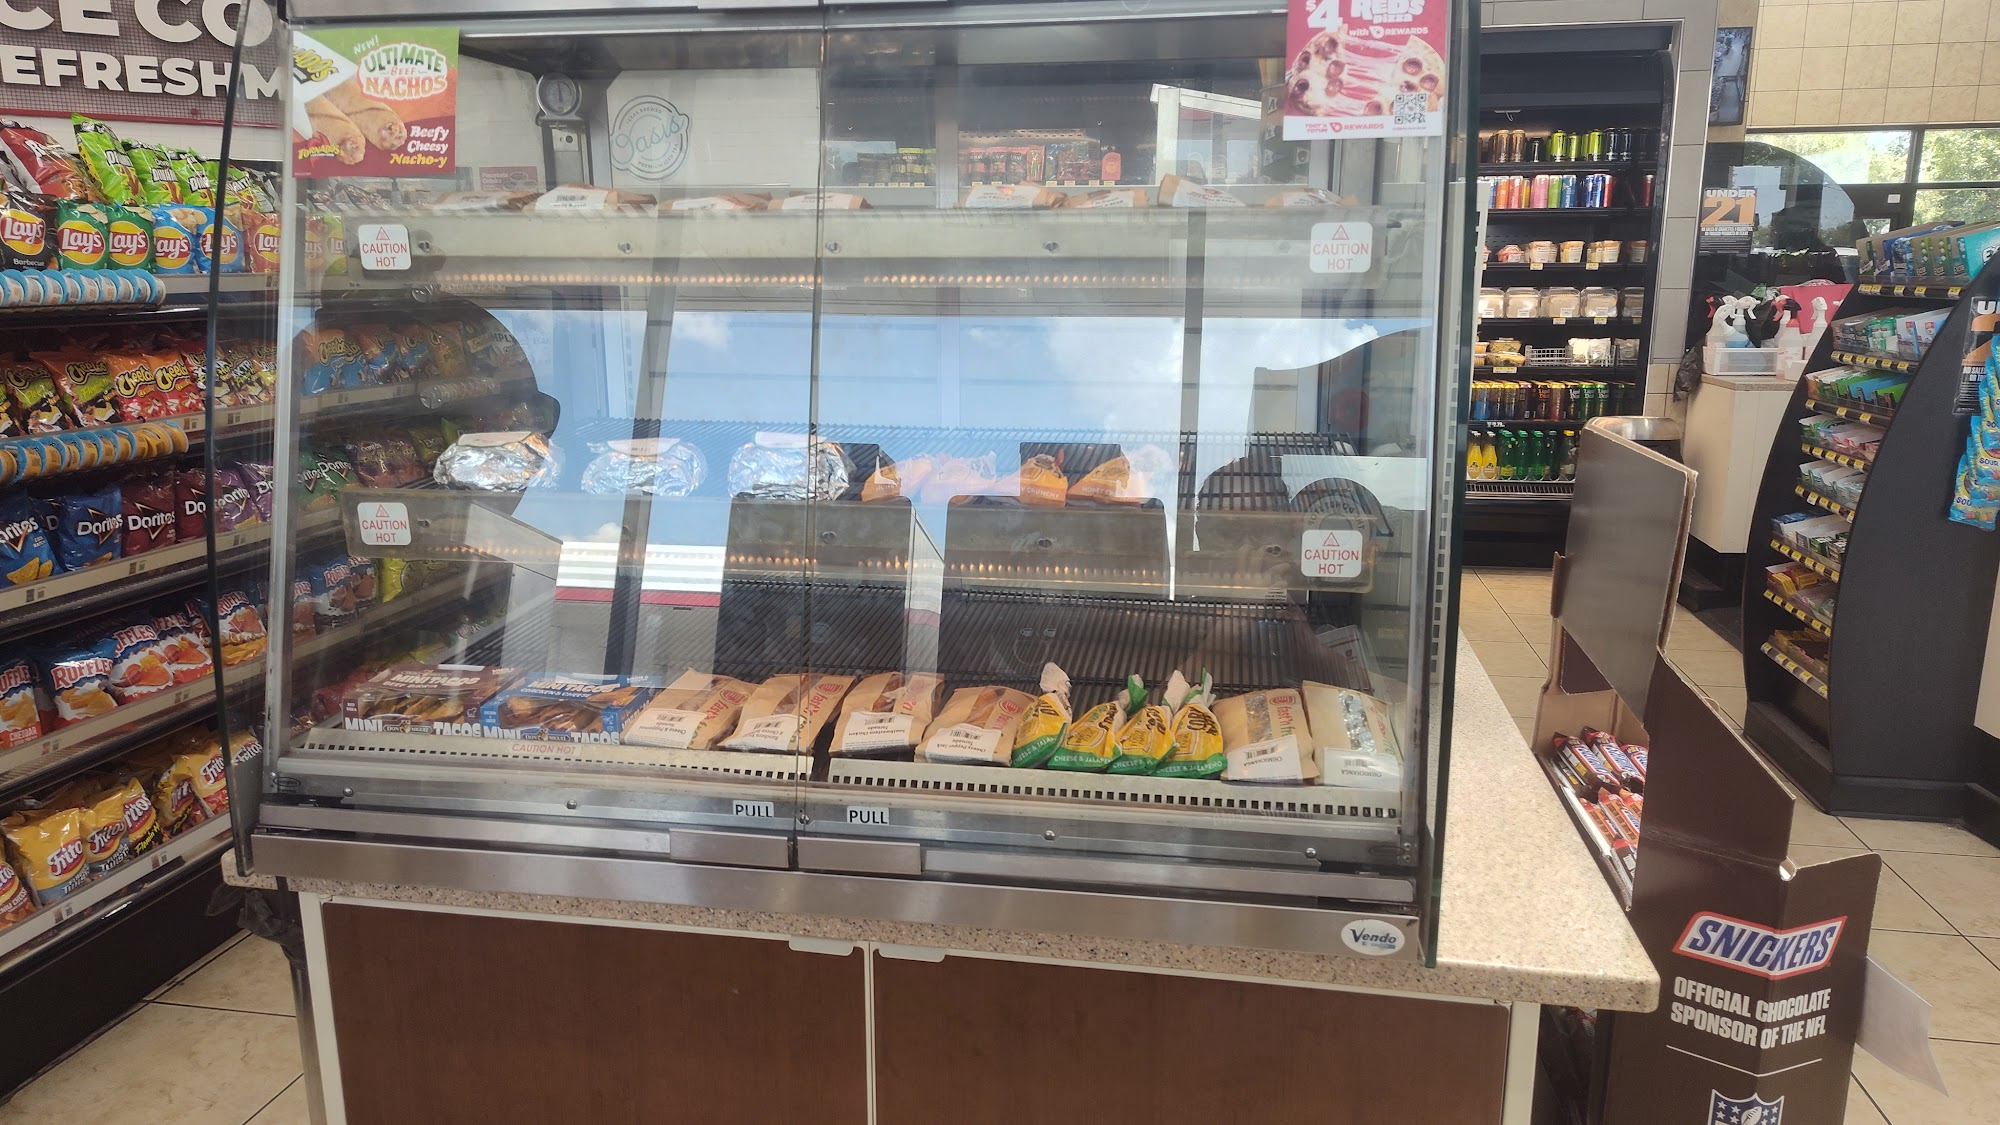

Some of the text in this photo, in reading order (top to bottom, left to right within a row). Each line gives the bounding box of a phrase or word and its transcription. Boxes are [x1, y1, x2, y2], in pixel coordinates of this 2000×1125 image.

[1349, 27, 1428, 36] with REWARDS
[363, 44, 445, 72] ULTIMATE
[391, 67, 416, 75] BEEF
[365, 75, 447, 98] NACHOS
[410, 126, 449, 141] Beefy
[298, 145, 341, 160] TORNADOS
[407, 140, 448, 154] Cheesy
[390, 153, 447, 168] Nacho-y
[1706, 189, 1756, 198] UNDER
[1701, 197, 1756, 226] 21
[4, 218, 44, 244] Lay's
[62, 229, 102, 254] Lay's
[154, 237, 189, 259] ay's
[362, 243, 407, 254] CAUTION
[1313, 243, 1369, 255] CAUTION
[13, 258, 45, 267] Barbecue
[376, 257, 396, 267] HOT
[1327, 258, 1353, 270] HOT
[117, 364, 153, 398] Cheeto
[155, 360, 190, 391] Cheeto
[1980, 457, 1999, 466] SOUR
[1026, 488, 1060, 498] CRUNCHY
[77, 513, 123, 536] Doritos
[362, 520, 407, 530] CAUTION
[376, 533, 396, 542] HOT
[1304, 549, 1359, 561] CAUTION
[1318, 563, 1344, 575] HOT
[391, 674, 429, 685] MINI
[429, 676, 481, 687] TACOS
[527, 680, 620, 693] MINI TACOS
[345, 717, 383, 732] MINI
[433, 721, 482, 737] TACOS
[483, 726, 521, 740] MINI
[570, 731, 620, 745] TACOS
[512, 743, 577, 754] CAUTION HOT
[1054, 755, 1077, 763] CHEESE
[1243, 756, 1283, 768] CHIMICHANGA
[735, 804, 773, 818] PULL
[849, 810, 888, 825] PULL
[87, 821, 128, 854] Fritos
[47, 839, 83, 876] Frito
[1349, 928, 1397, 944] Vendo
[1687, 919, 1837, 972] SNICKERS
[1674, 976, 1832, 1023] OFFICIAL CHOCOLATE
[1670, 1001, 1827, 1050] SPONSOR OF THE NFL
